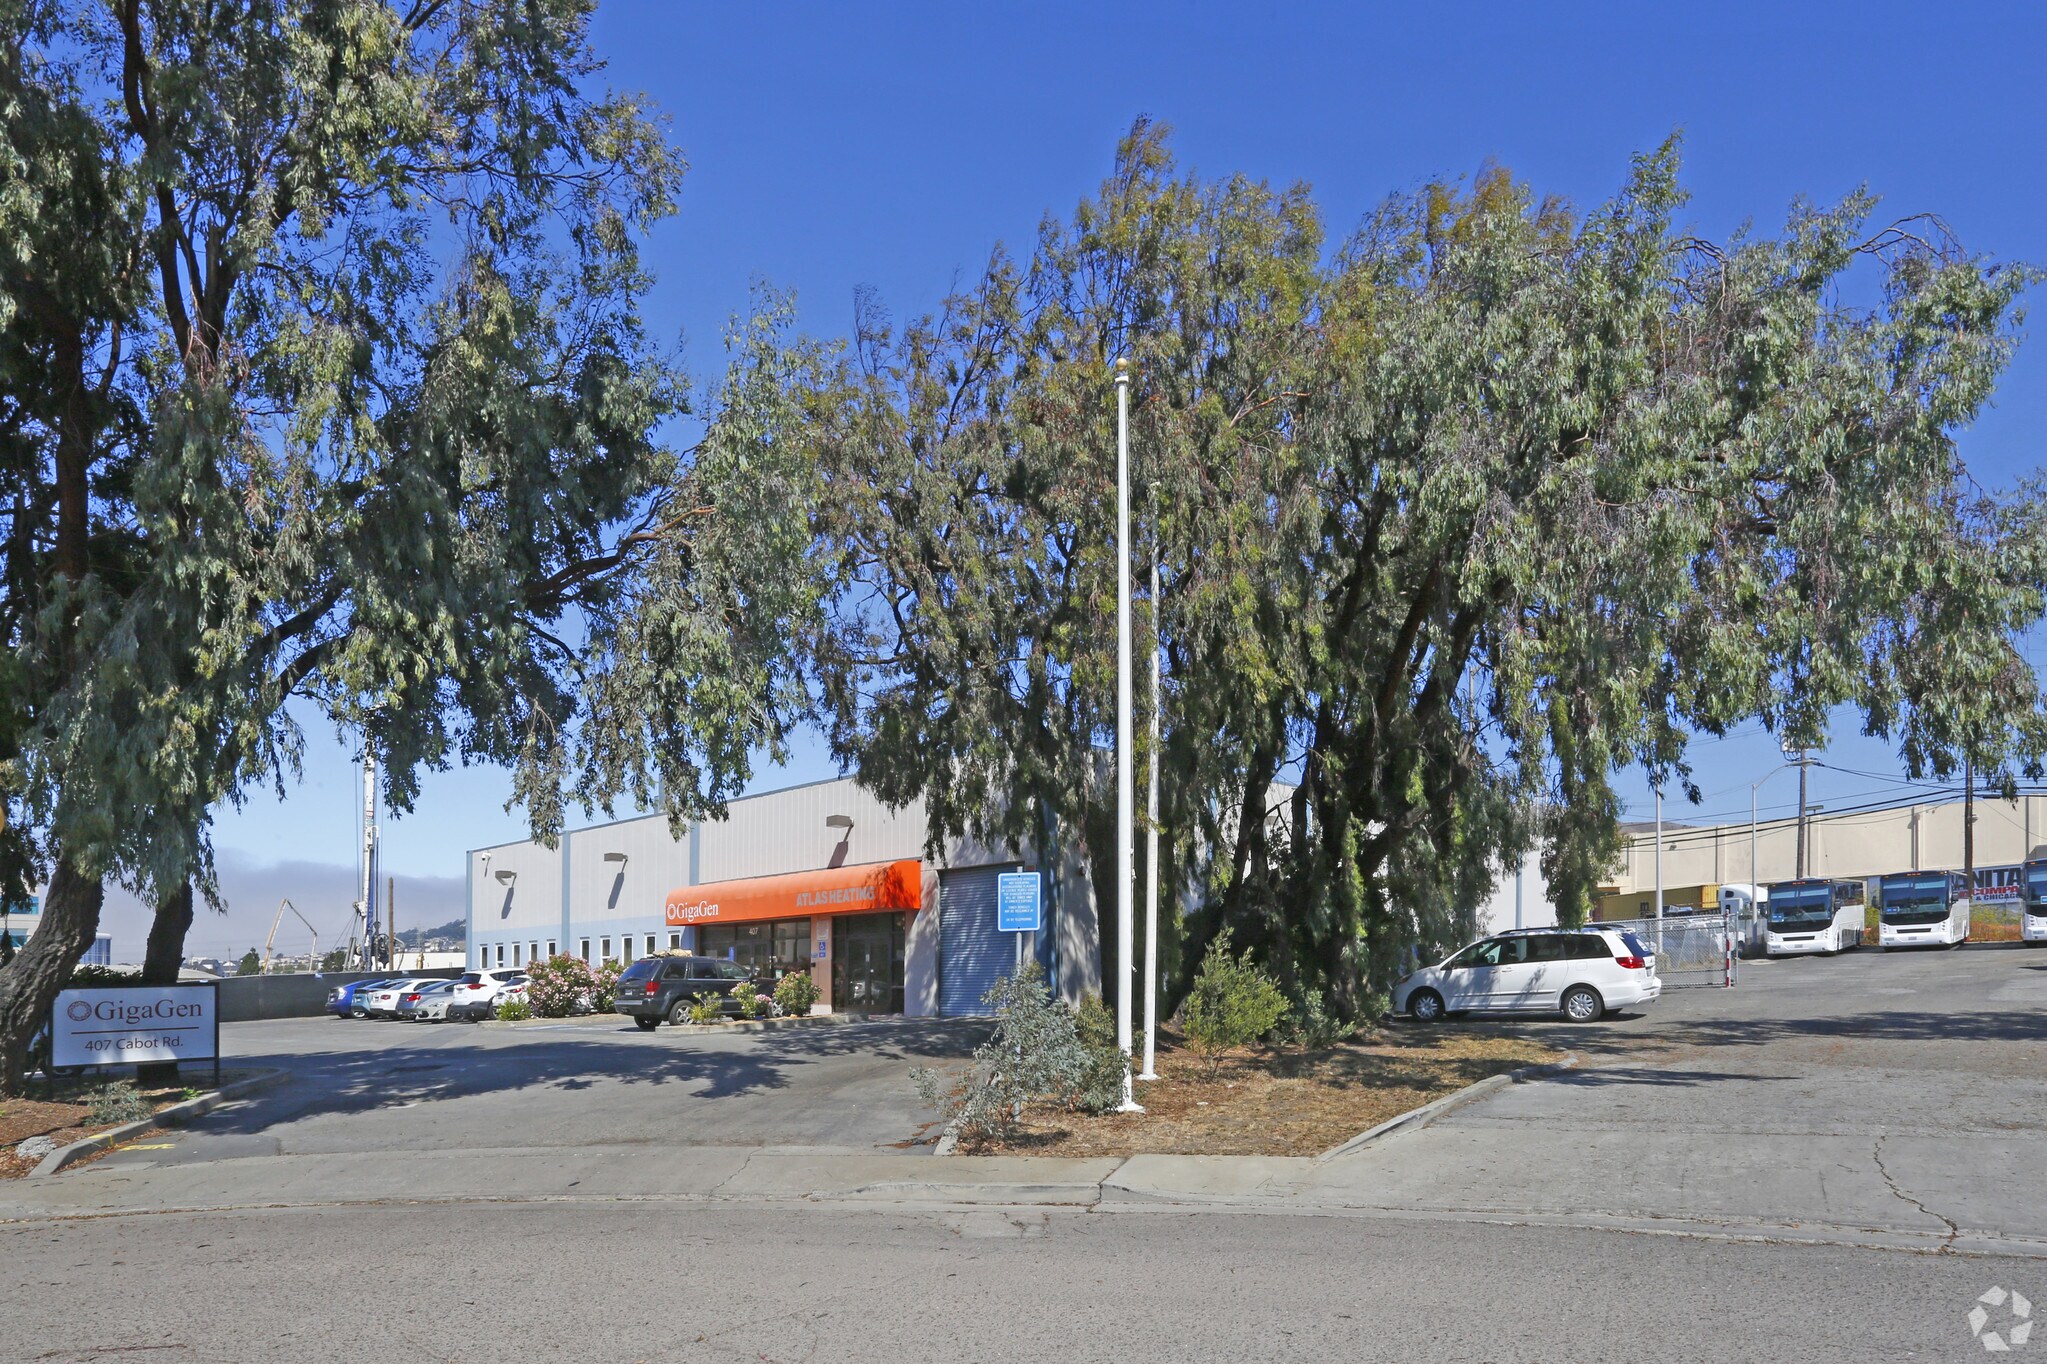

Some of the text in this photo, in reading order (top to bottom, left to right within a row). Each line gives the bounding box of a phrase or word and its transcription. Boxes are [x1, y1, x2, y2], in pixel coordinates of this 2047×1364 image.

[676, 900, 719, 922] GigaGen
[748, 927, 759, 936] 407
[94, 999, 203, 1024] GigaGen
[85, 1036, 184, 1051] 407 Cabot Rd.
